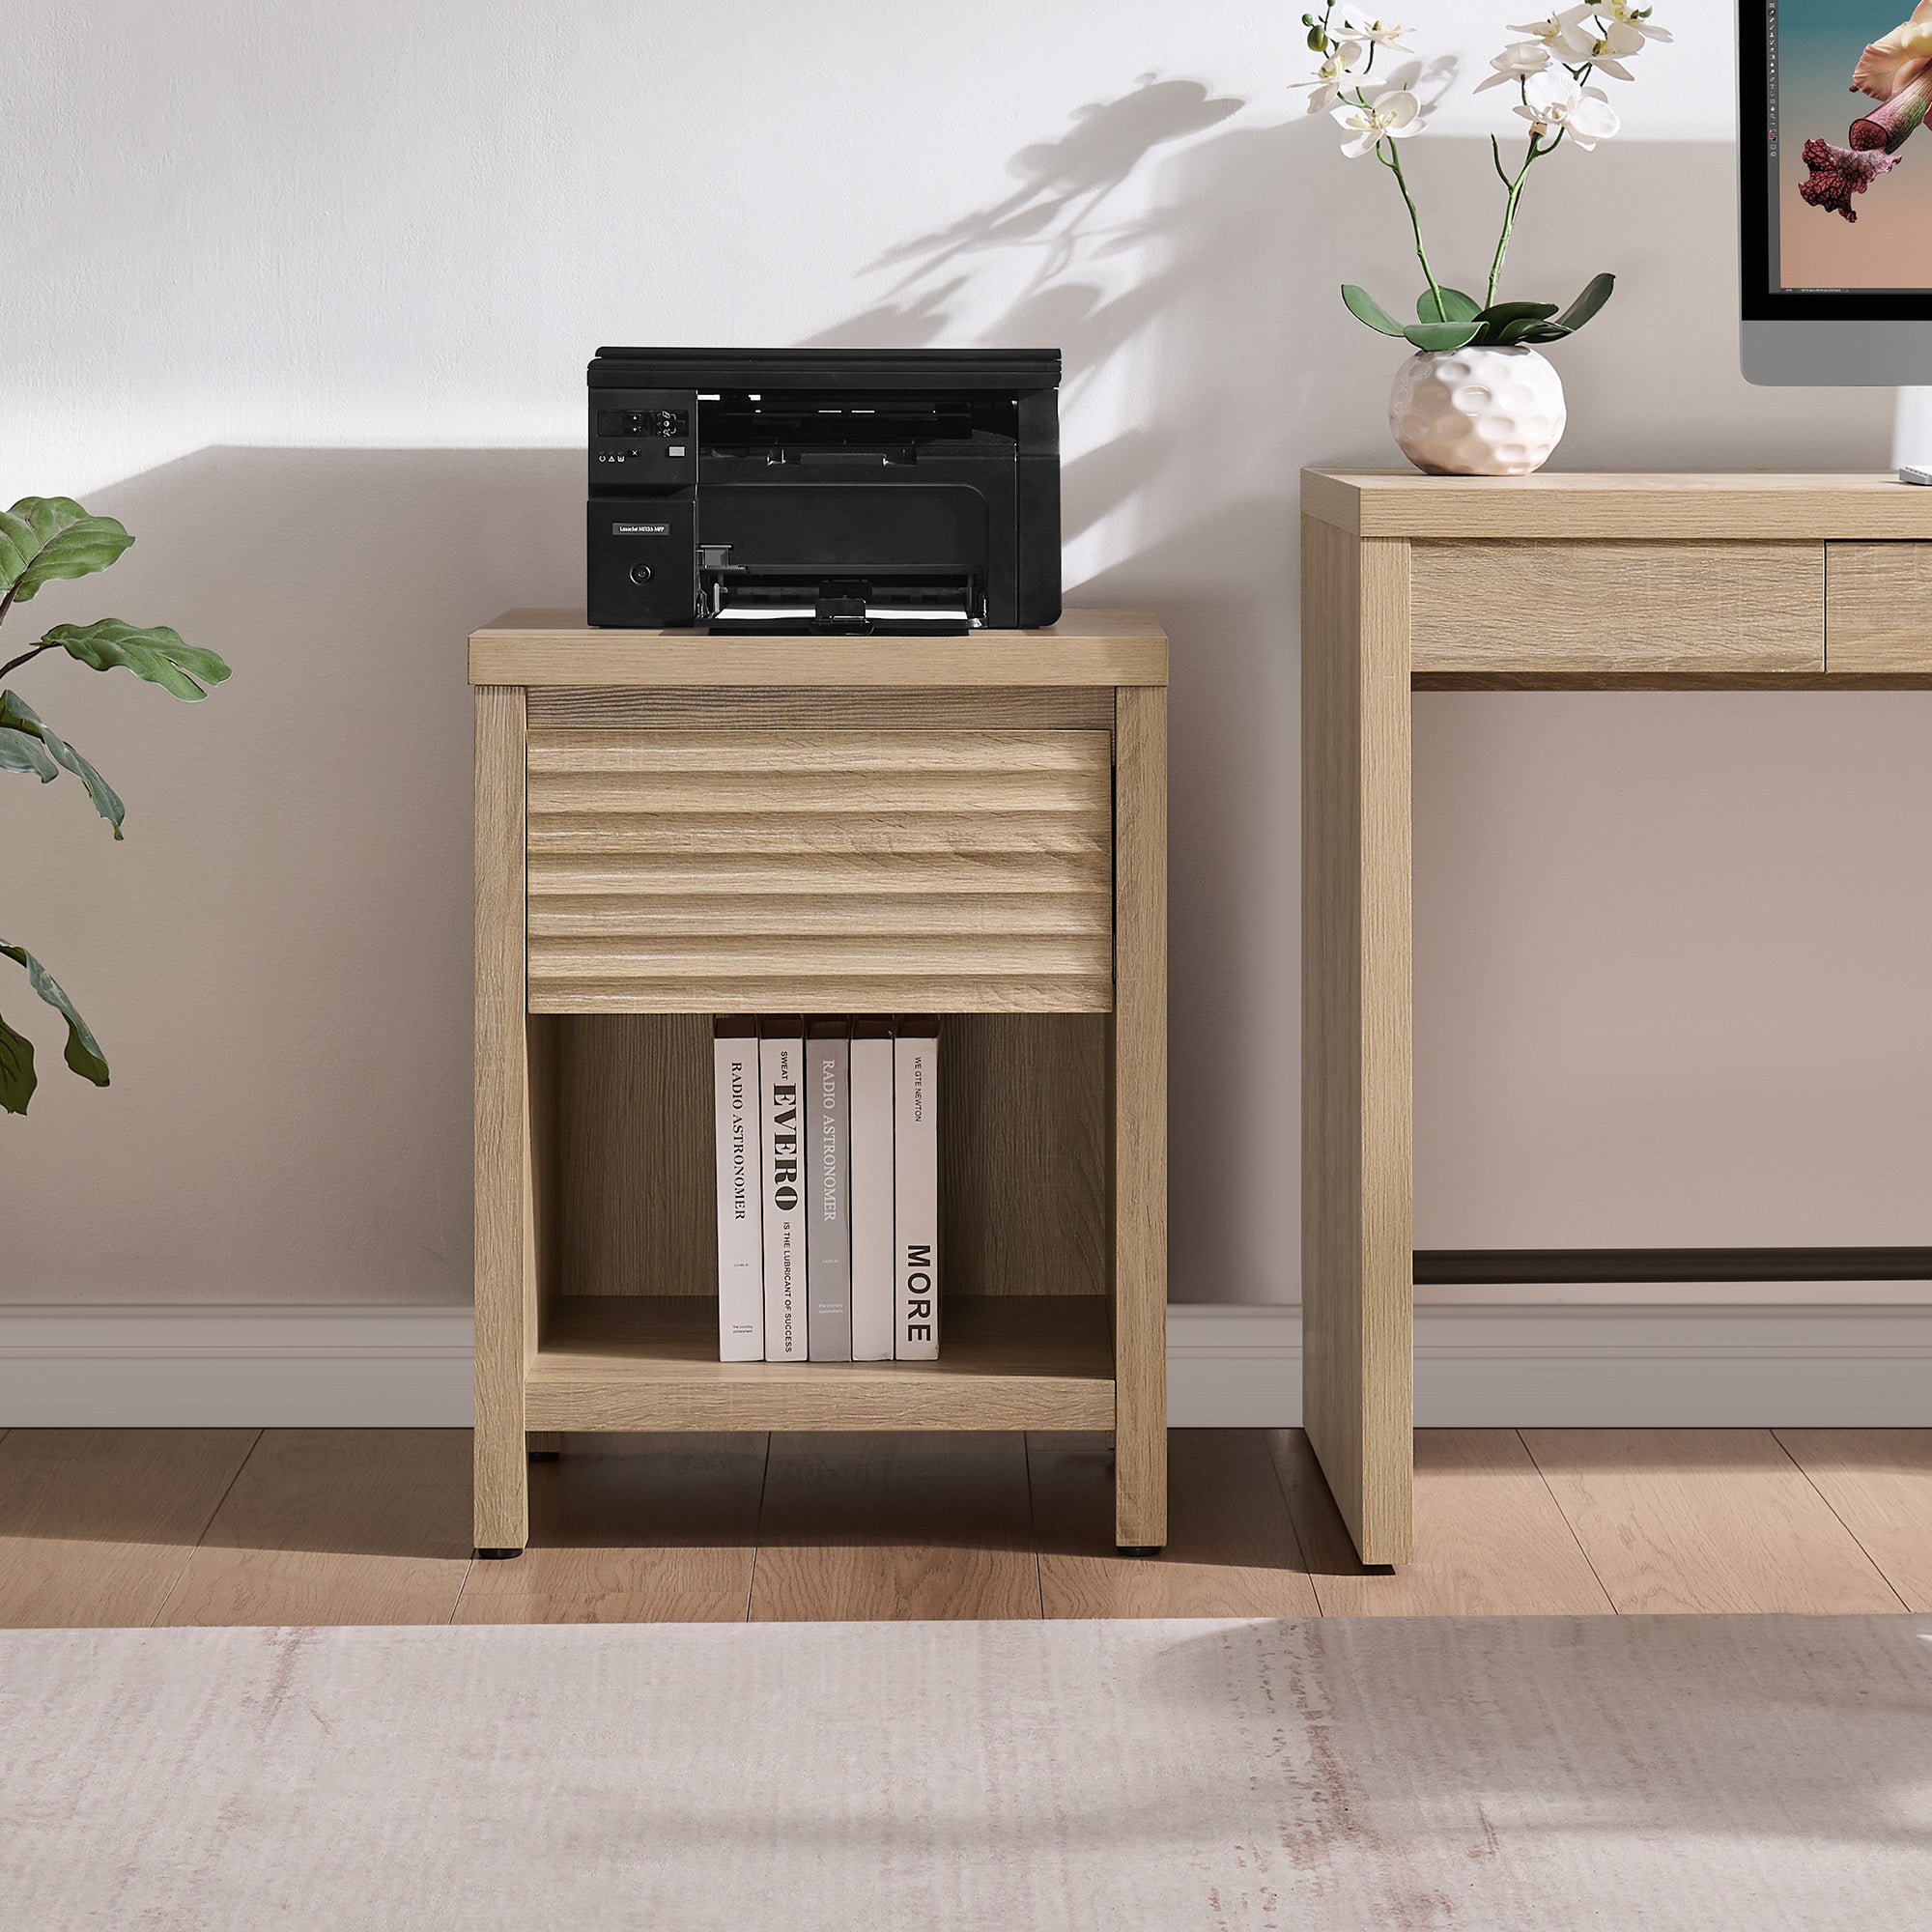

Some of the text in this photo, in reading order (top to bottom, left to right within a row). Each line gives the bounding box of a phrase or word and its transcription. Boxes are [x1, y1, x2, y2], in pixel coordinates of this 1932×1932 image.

[915, 1056, 922, 1069] WE
[731, 1062, 746, 1220] RADIO ASTRONOMER
[773, 1083, 798, 1210] EVERO
[822, 1059, 837, 1222] RADIO ASTRONOMER
[784, 1300, 792, 1311] OF
[907, 1244, 931, 1342] MORE
